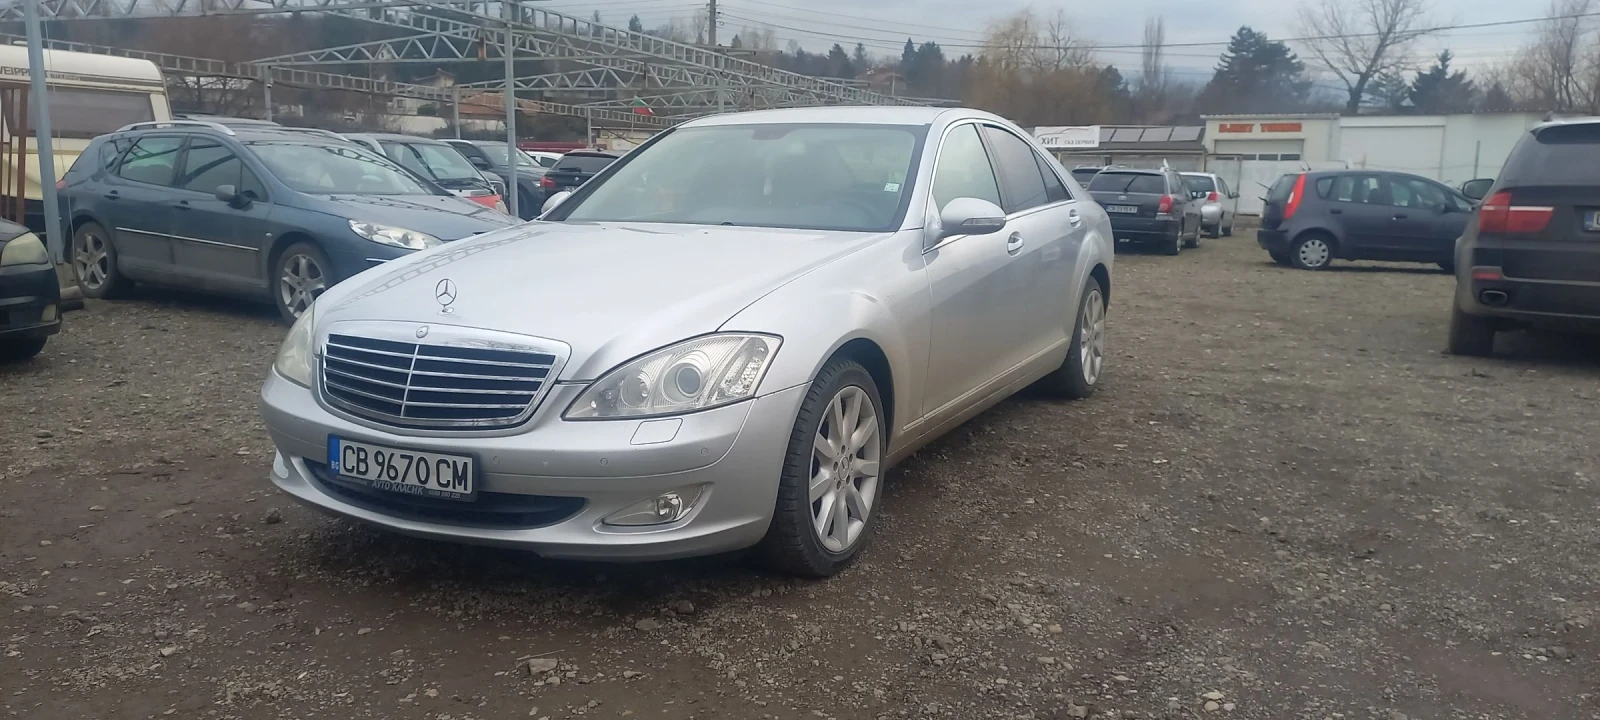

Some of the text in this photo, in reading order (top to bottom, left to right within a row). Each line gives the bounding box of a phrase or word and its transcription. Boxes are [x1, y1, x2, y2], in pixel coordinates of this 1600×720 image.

[330, 460, 339, 470] BG
[342, 445, 467, 491] CB 9670 CM
[392, 483, 424, 495] КЛАСИК
